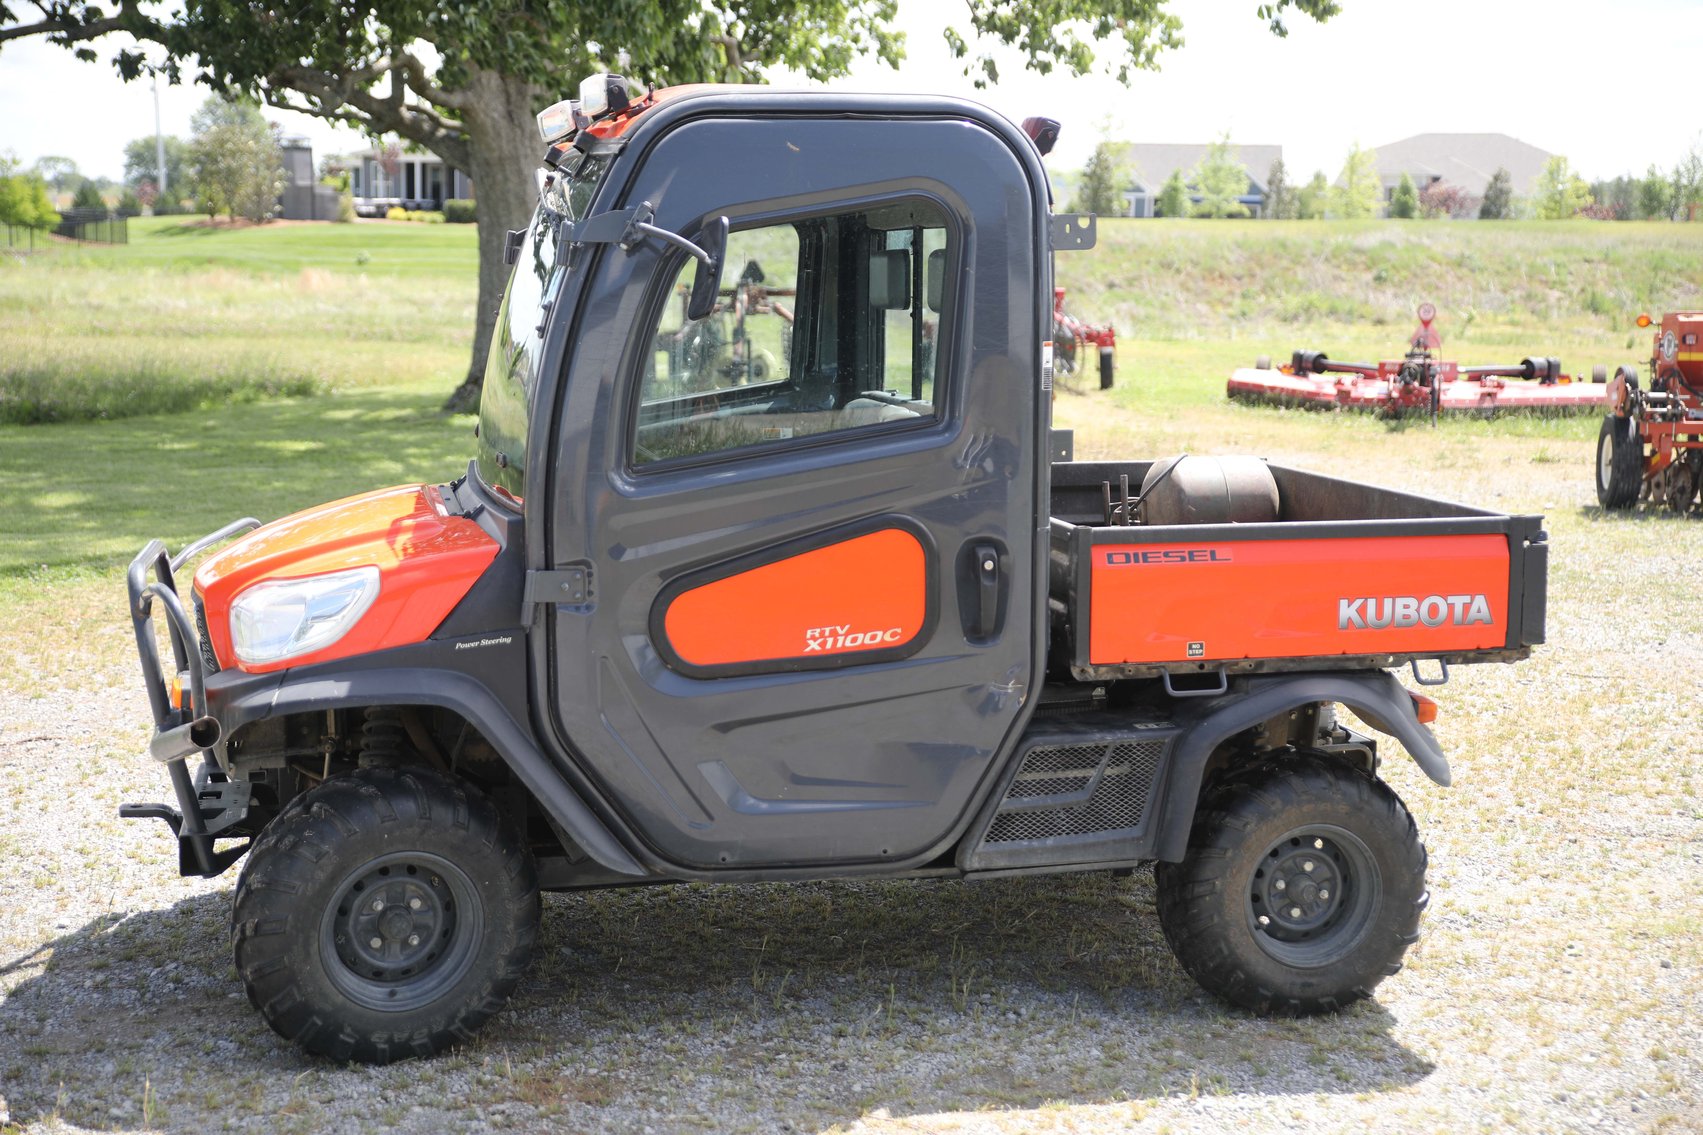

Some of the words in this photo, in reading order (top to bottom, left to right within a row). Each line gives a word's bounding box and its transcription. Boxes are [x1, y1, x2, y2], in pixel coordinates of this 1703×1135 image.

[1106, 550, 1231, 565] DIESEL
[1338, 594, 1494, 630] KUBOTA
[806, 624, 851, 639] RTV
[455, 641, 480, 650] Power
[480, 636, 512, 645] Steering
[803, 627, 902, 652] X1100C
